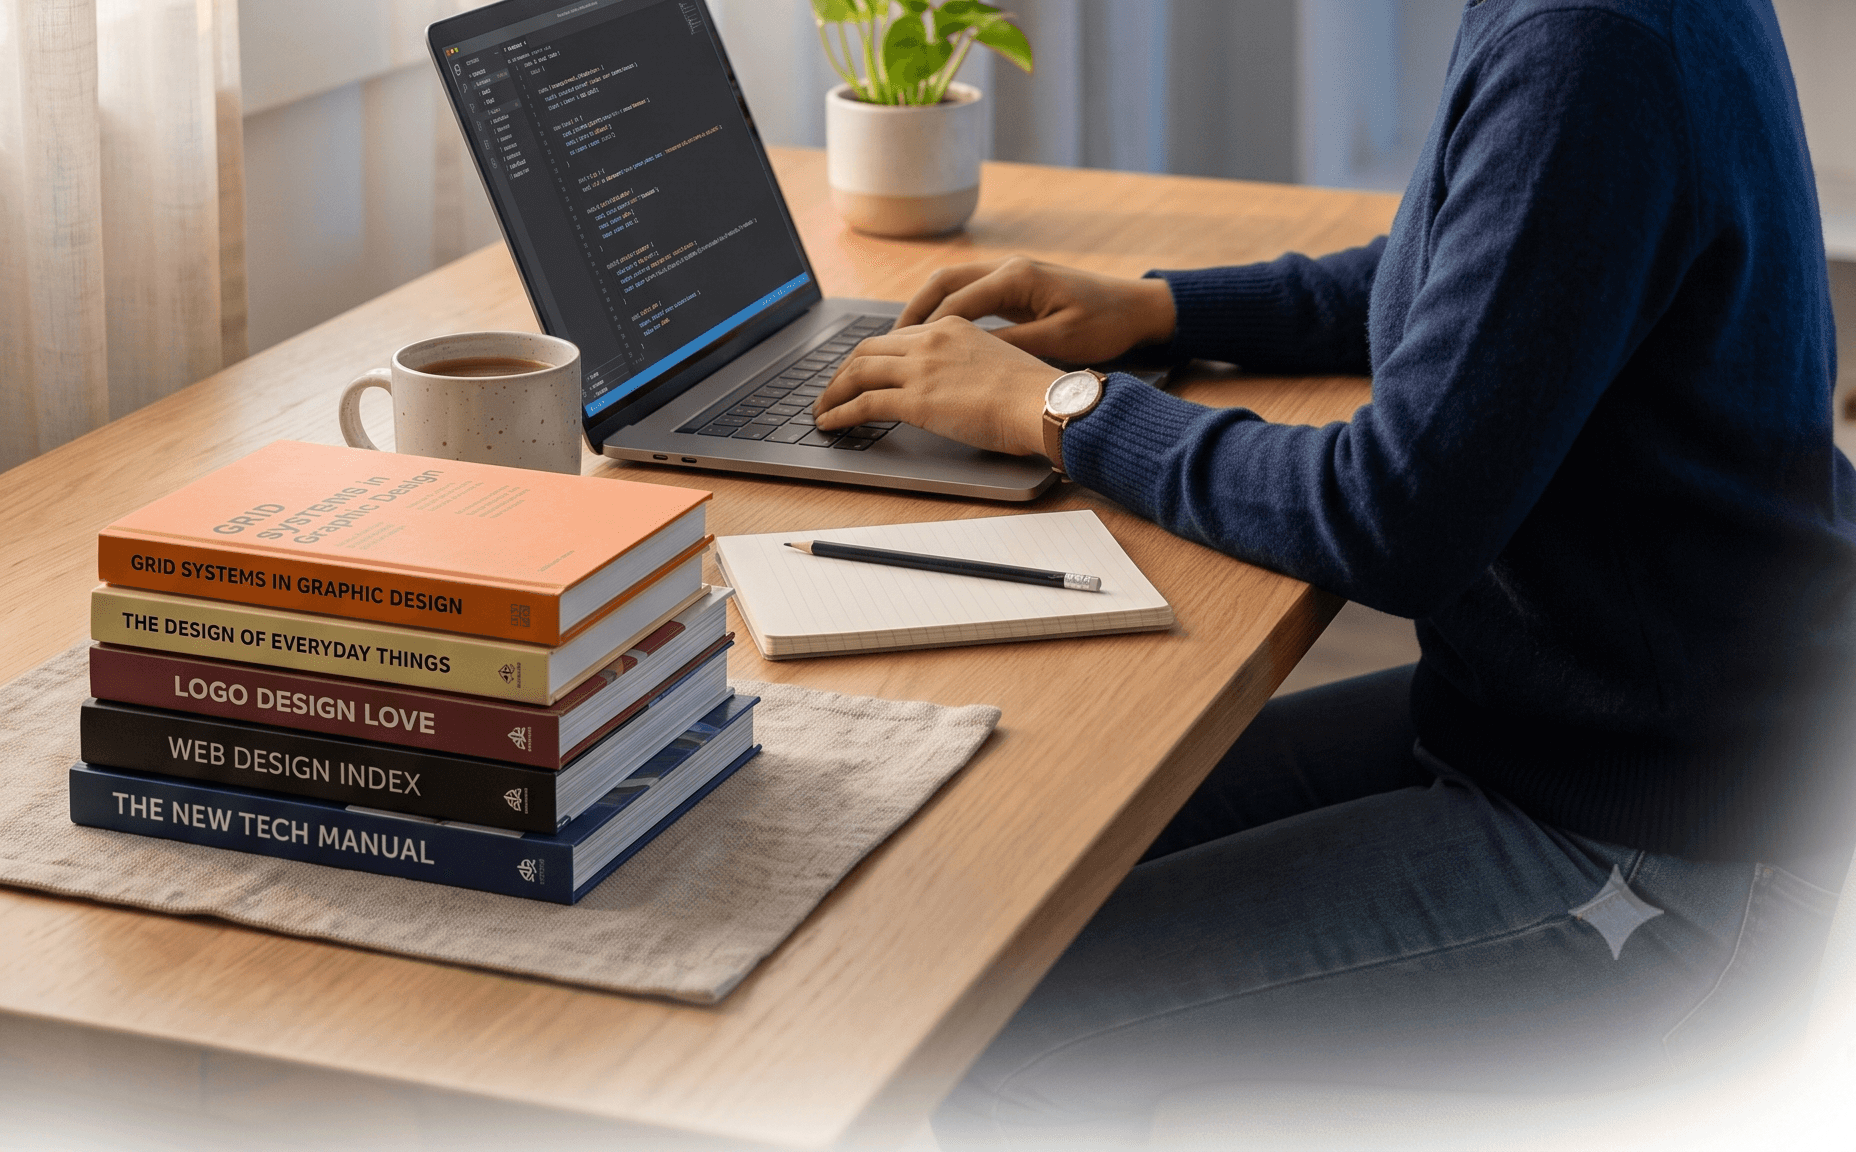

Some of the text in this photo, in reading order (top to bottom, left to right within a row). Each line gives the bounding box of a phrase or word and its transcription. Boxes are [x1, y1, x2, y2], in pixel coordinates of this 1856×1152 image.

[355, 476, 391, 487] in
[212, 503, 286, 535] GRID
[293, 504, 380, 544] Graphic
[131, 554, 463, 615] GRID SYSTEMS IN GRAPHIC DESIGN
[122, 612, 451, 673] THE DESIGN OF EVERYDAY THINGS
[174, 675, 435, 735] LOGO DESIGN LOVE
[168, 736, 421, 796] WEB DESIGN INDEX
[112, 792, 435, 865] THE NEW TECH MANUAL
